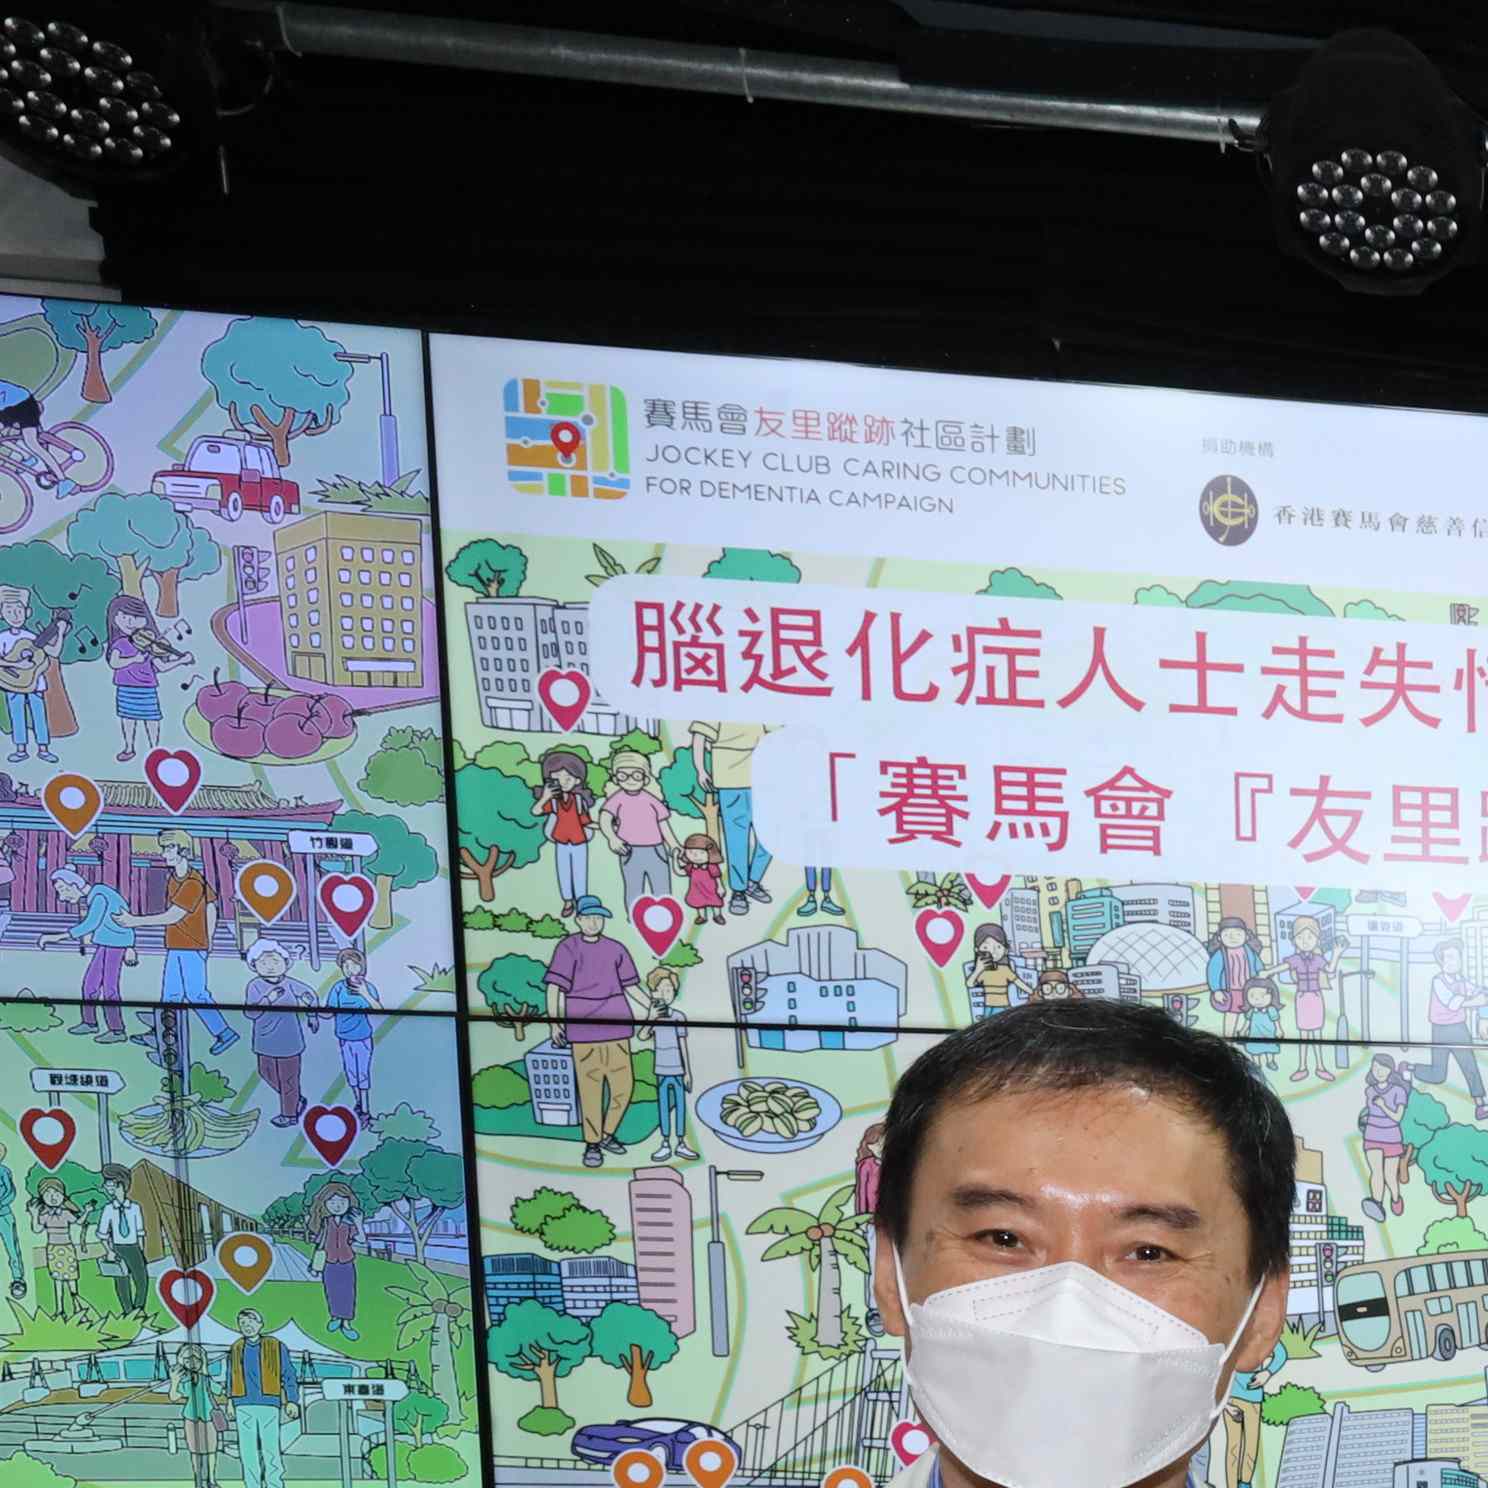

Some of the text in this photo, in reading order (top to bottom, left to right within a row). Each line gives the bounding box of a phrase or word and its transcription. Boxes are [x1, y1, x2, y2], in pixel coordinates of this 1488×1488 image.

[643, 397, 1036, 456] 賽馬會友里蹤跡社區計劃
[646, 444, 1126, 496] JOCKEY CLUB CARING COMMUNITIES
[646, 476, 954, 514] FOR DEMENTIA CAMPAIGN
